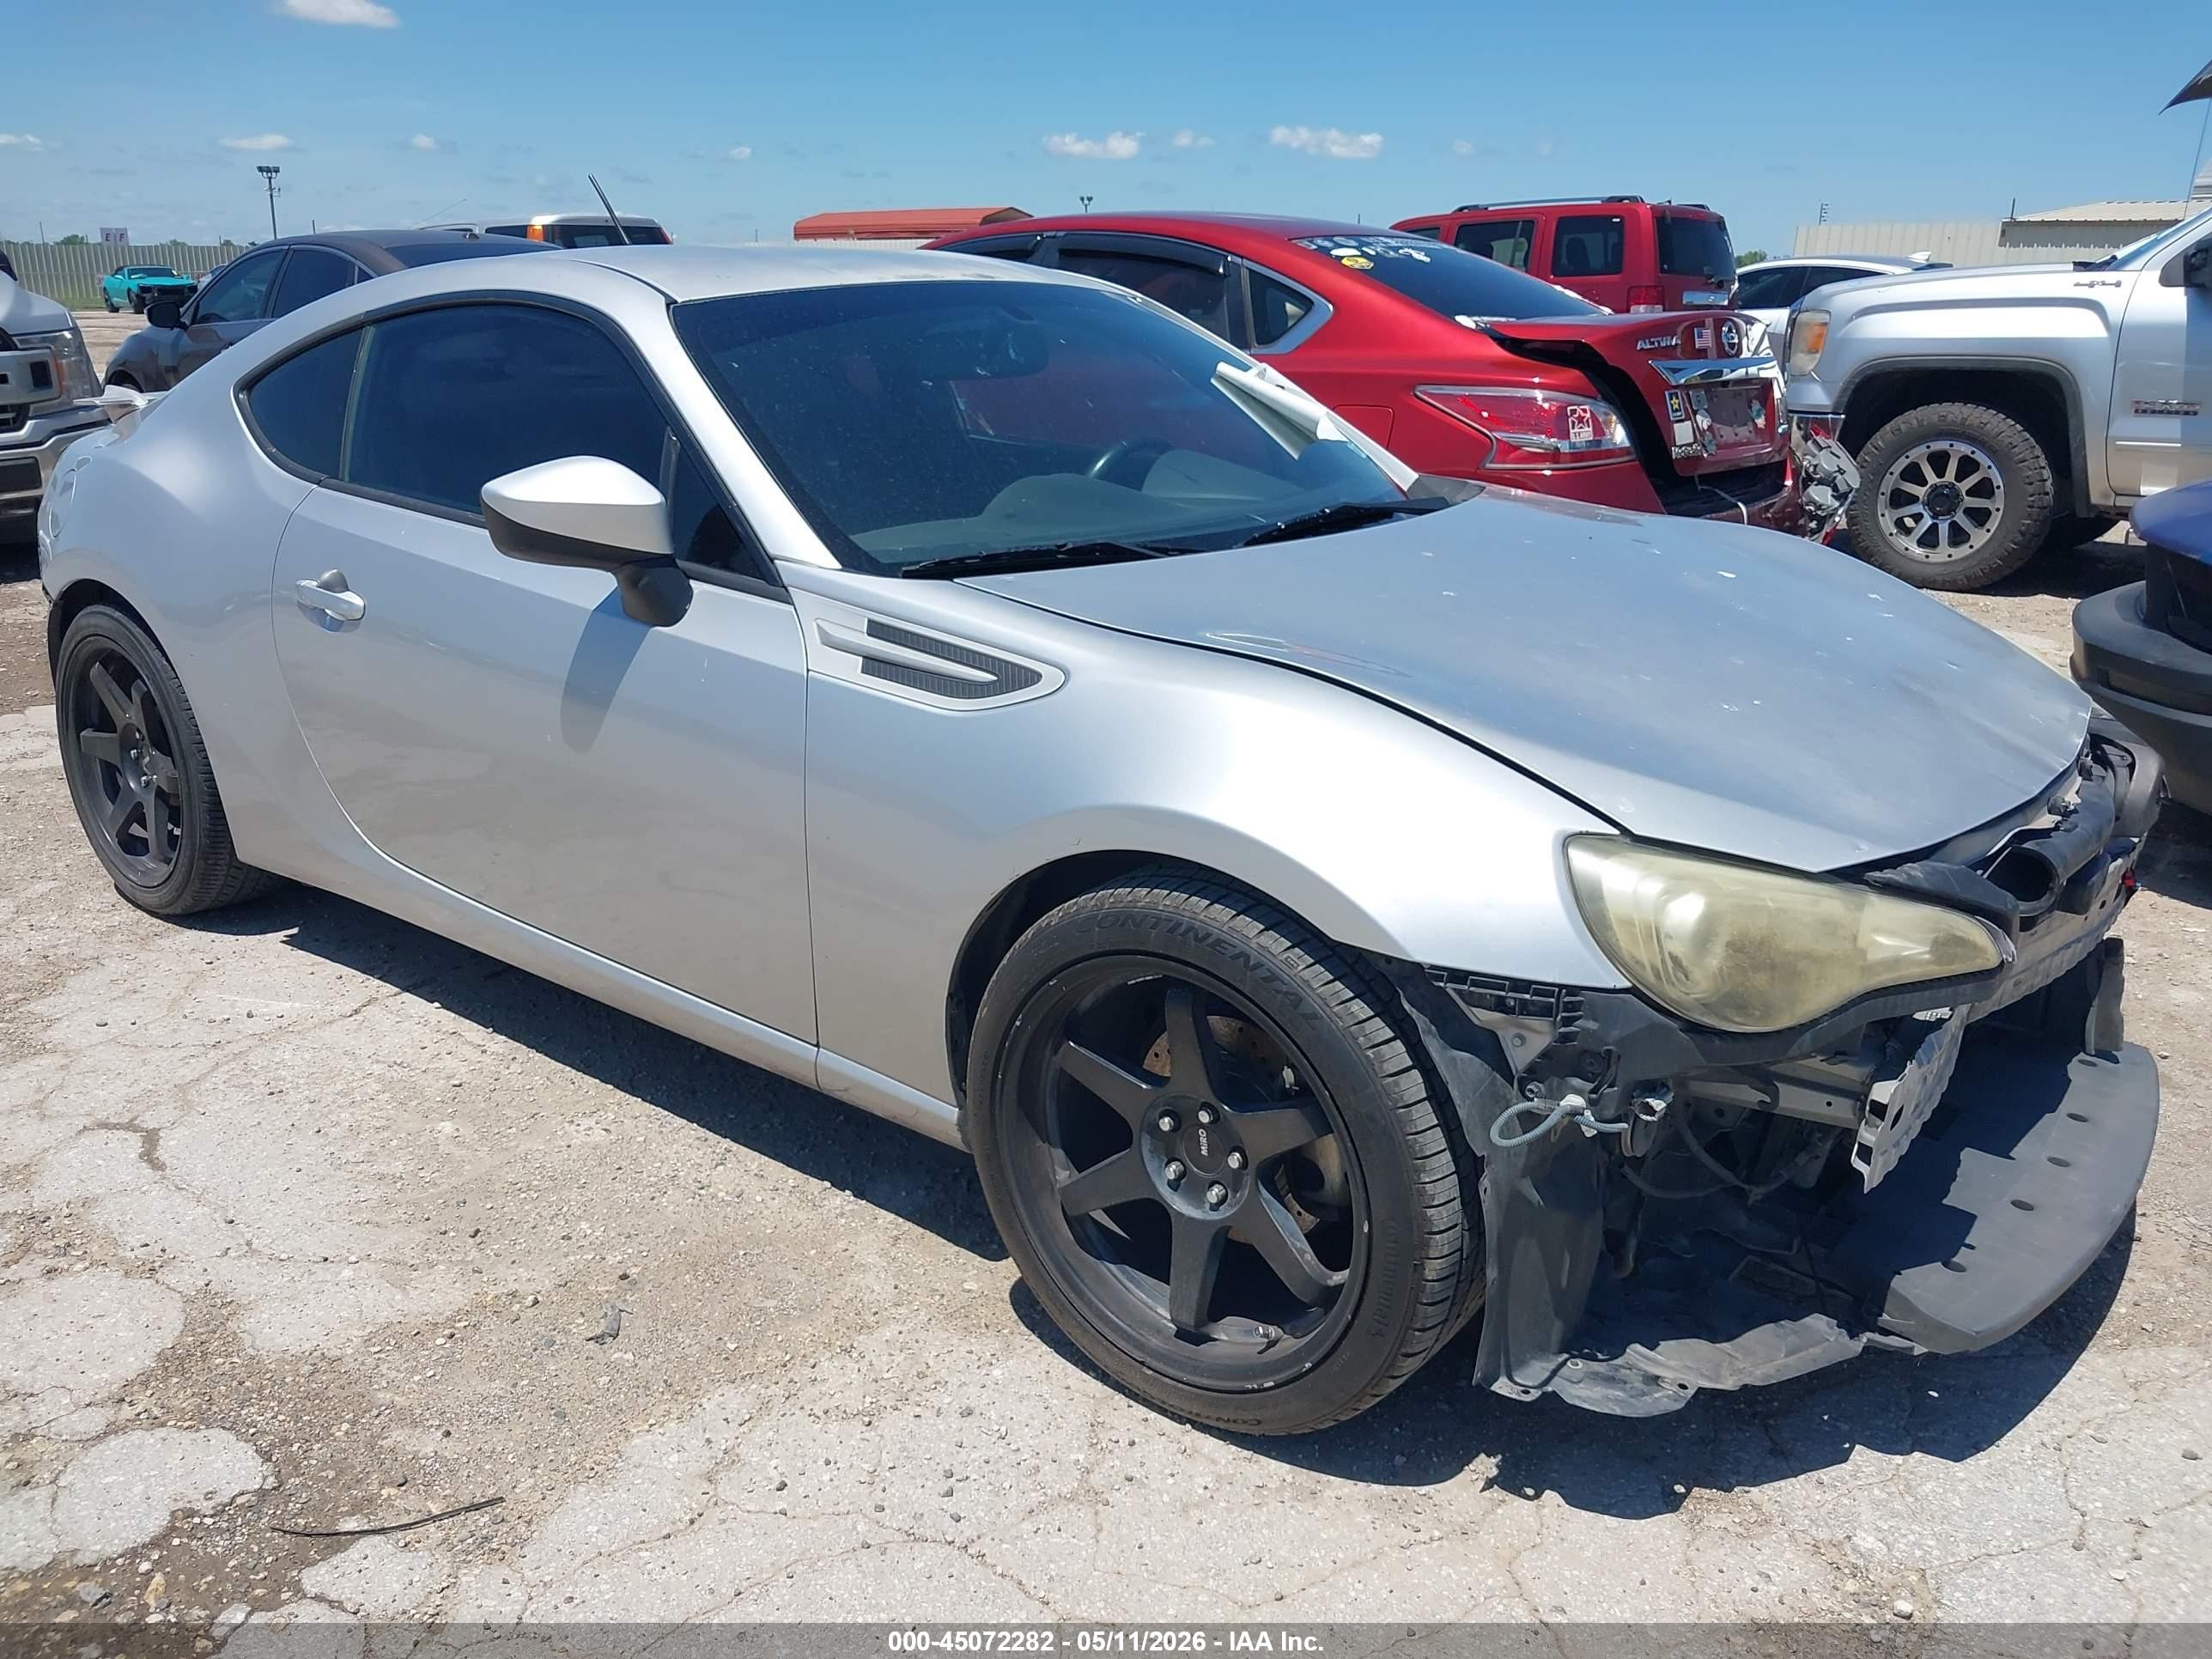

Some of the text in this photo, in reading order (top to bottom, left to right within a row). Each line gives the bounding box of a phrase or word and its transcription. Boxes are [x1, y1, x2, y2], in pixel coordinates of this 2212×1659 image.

[106, 233, 111, 241] E
[119, 233, 125, 242] F
[1637, 336, 1681, 350] ALTIMA
[1073, 910, 1323, 1029] CONTINENTAL
